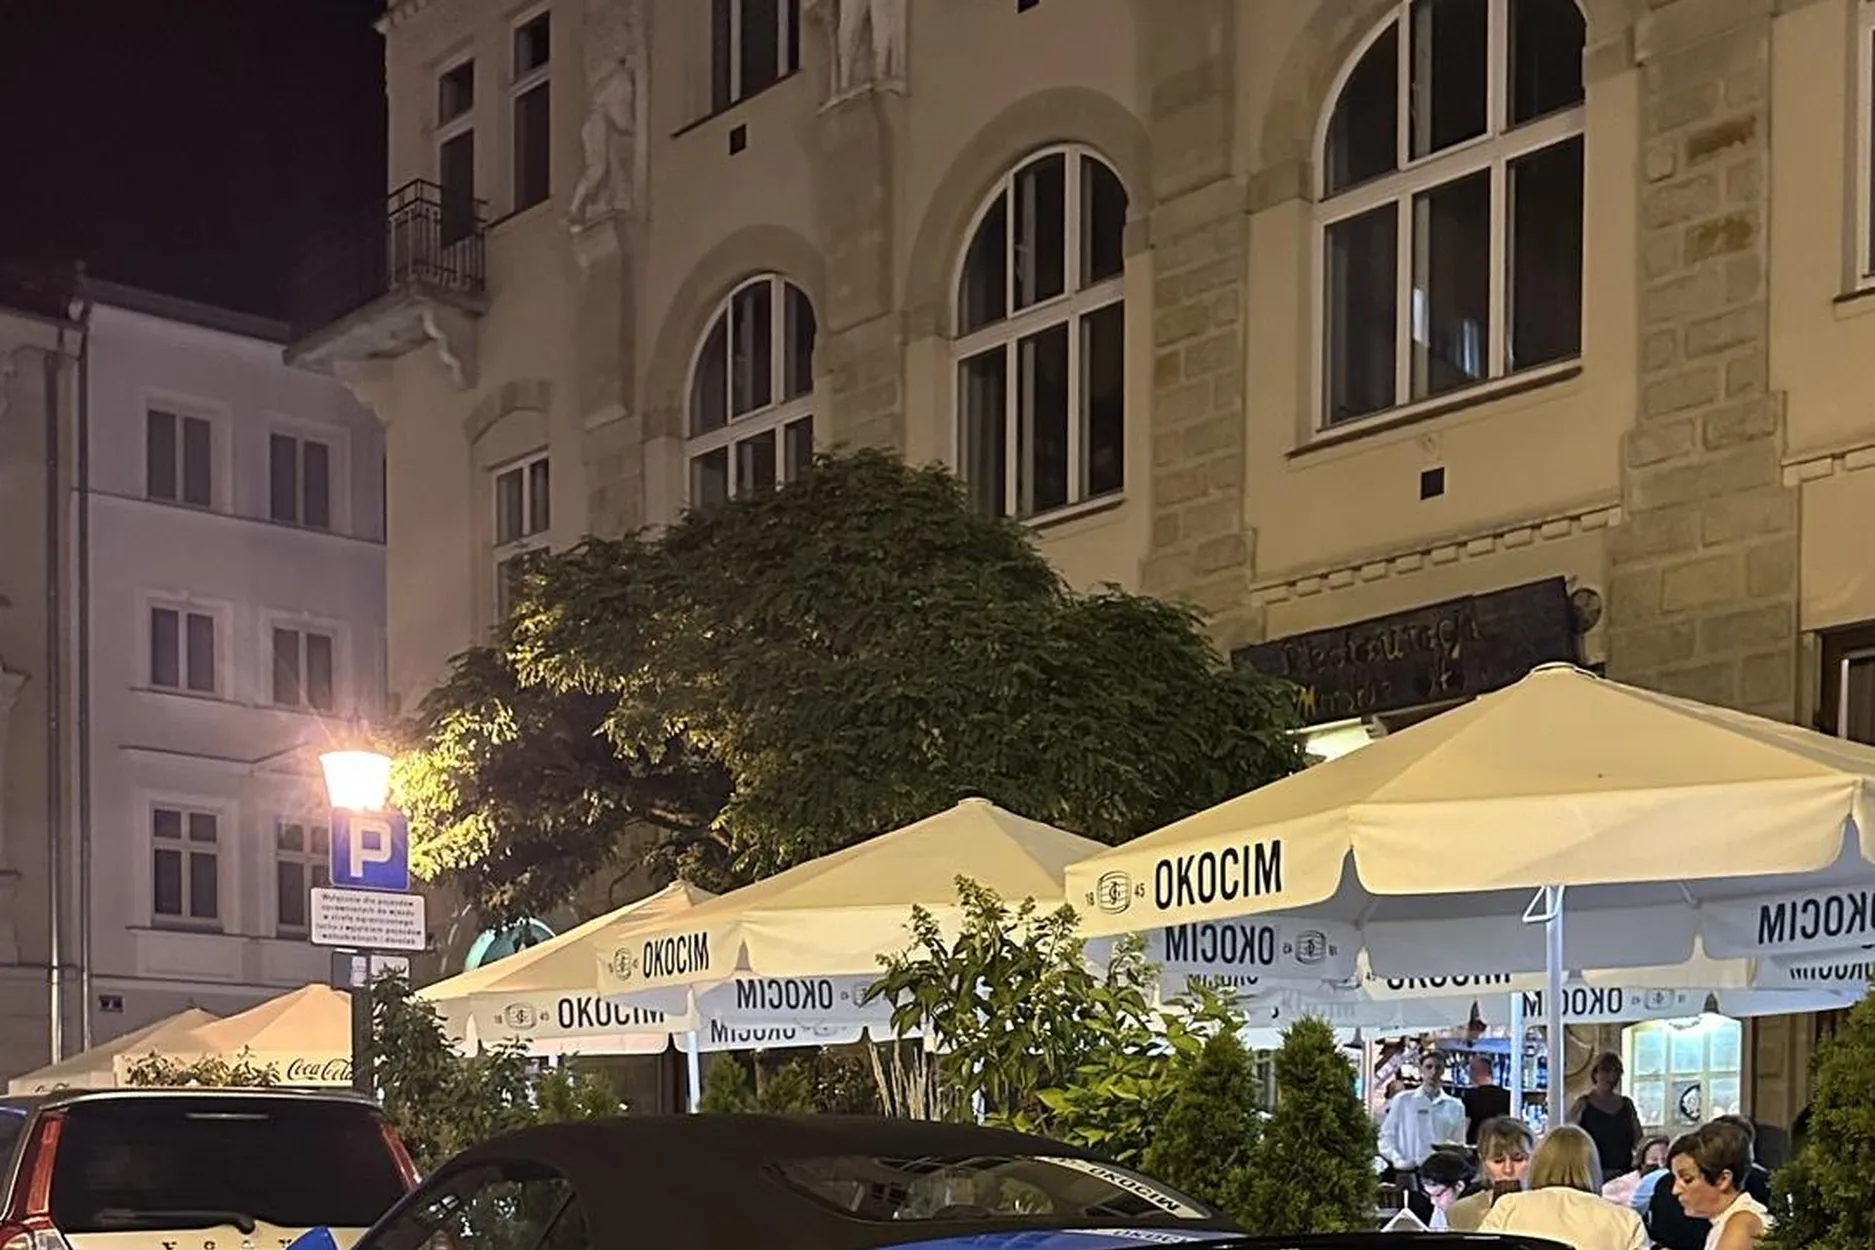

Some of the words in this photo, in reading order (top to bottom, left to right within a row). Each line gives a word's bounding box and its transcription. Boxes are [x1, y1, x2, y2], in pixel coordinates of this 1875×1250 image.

[349, 817, 392, 878] P
[1155, 840, 1281, 910] OKOCIM
[643, 932, 709, 979] OKOCIM
